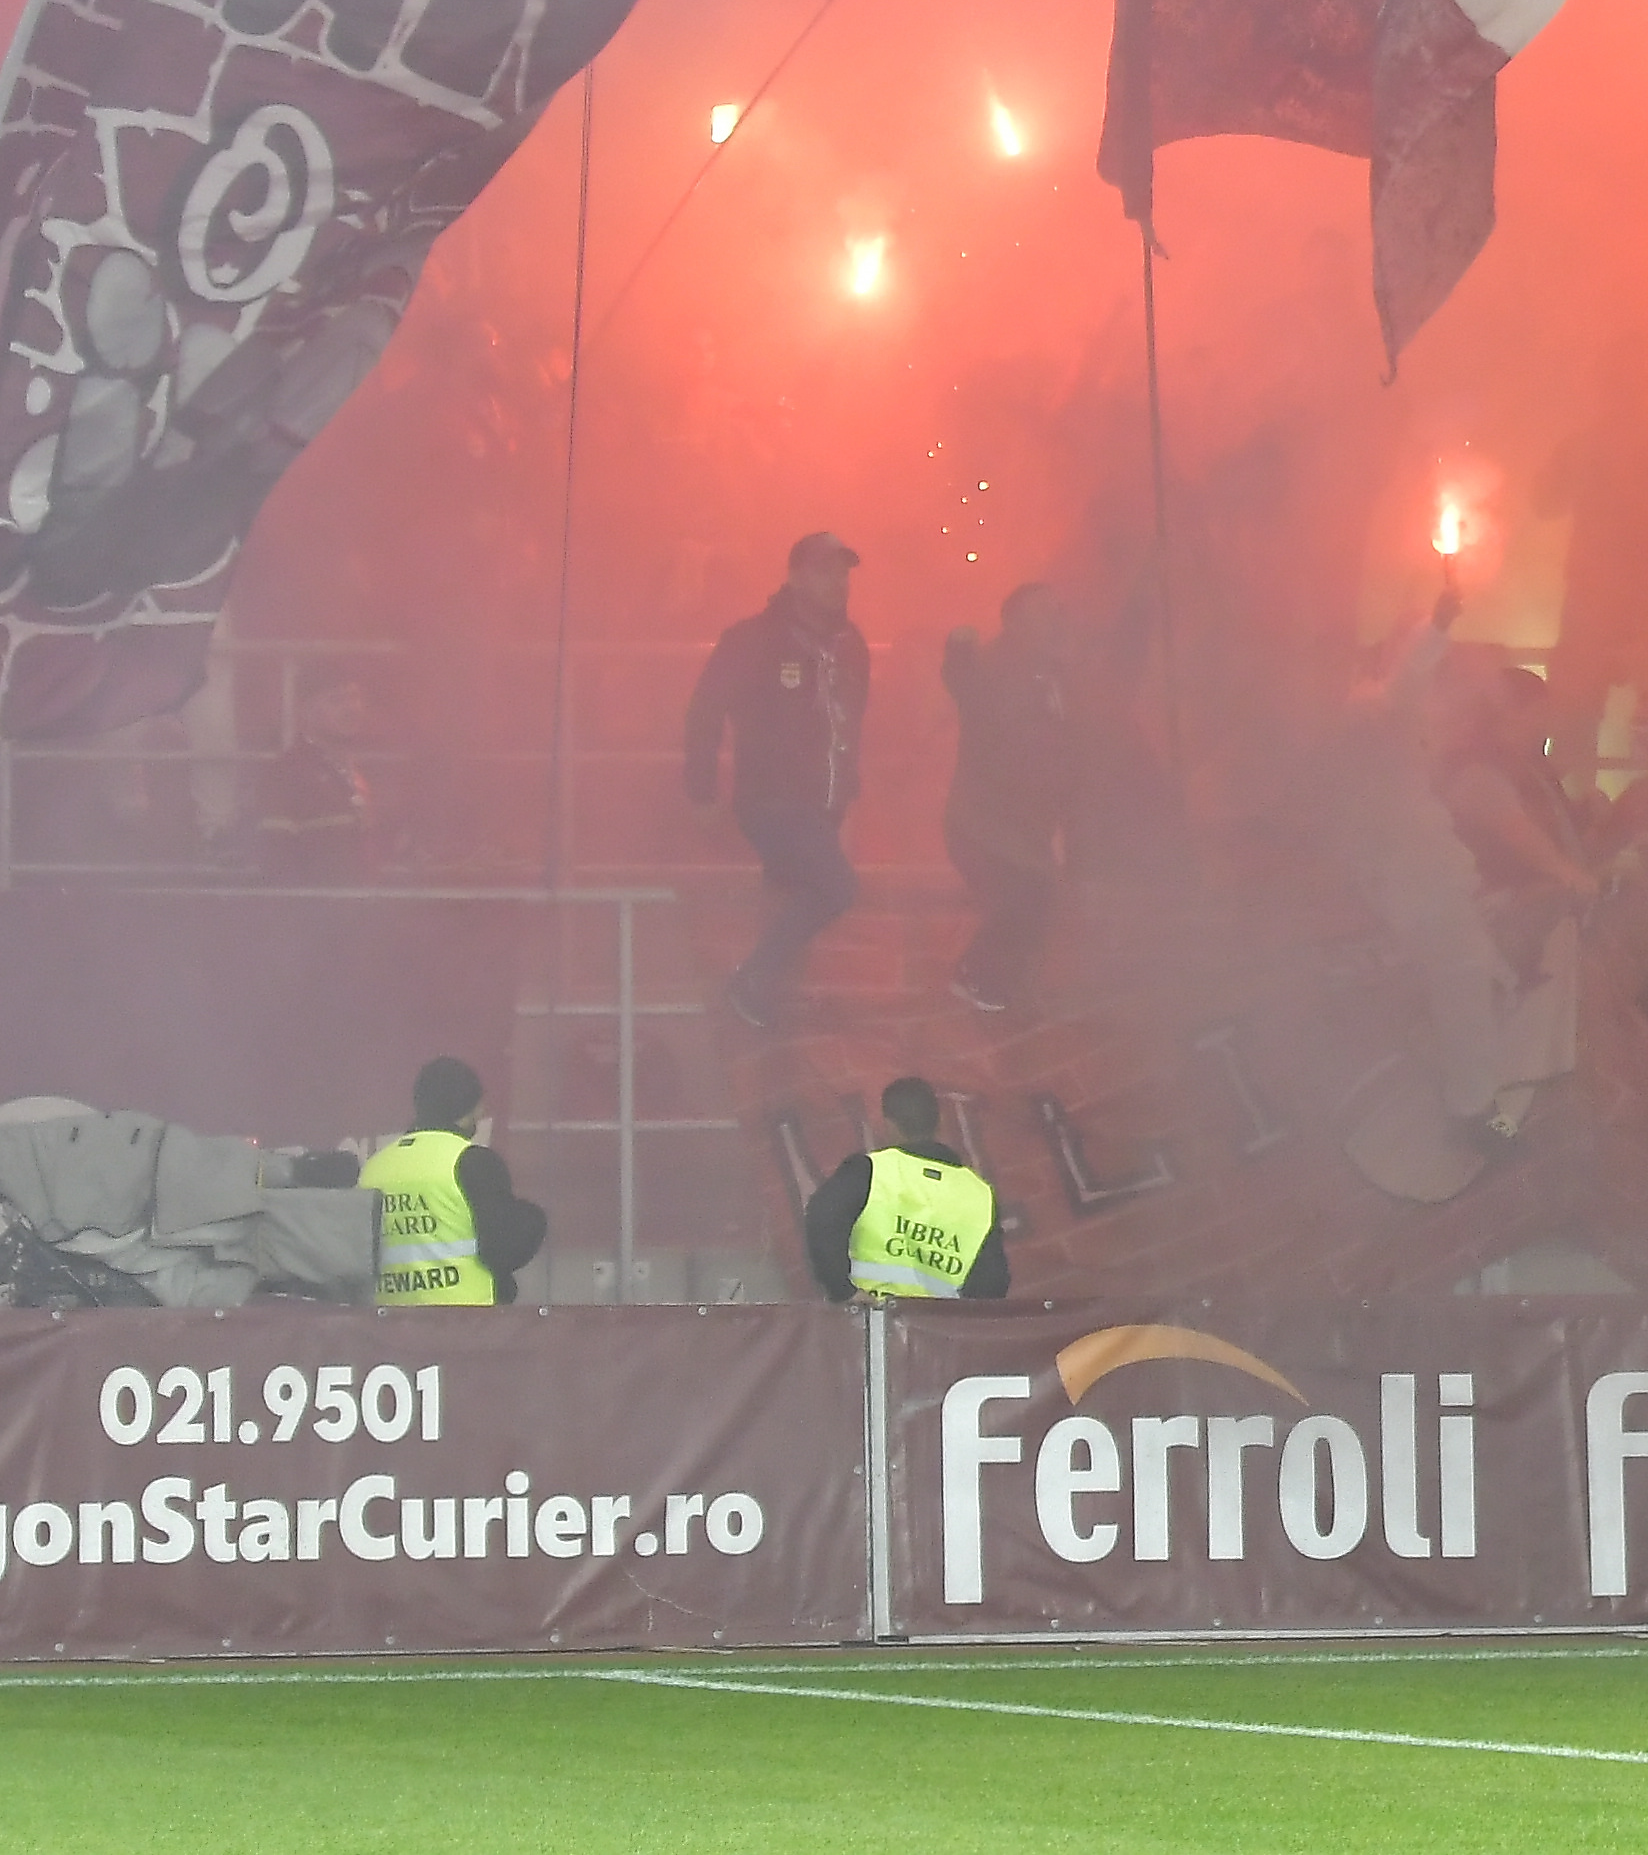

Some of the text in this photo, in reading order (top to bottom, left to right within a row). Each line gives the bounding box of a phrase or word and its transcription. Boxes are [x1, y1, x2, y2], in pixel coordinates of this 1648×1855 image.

[382, 1193, 429, 1224] BRA
[383, 1214, 437, 1236] ARD
[378, 1265, 460, 1294] EWARD
[99, 1364, 442, 1446] 021.9501
[0, 1469, 764, 1582] onStarCurier.ro
